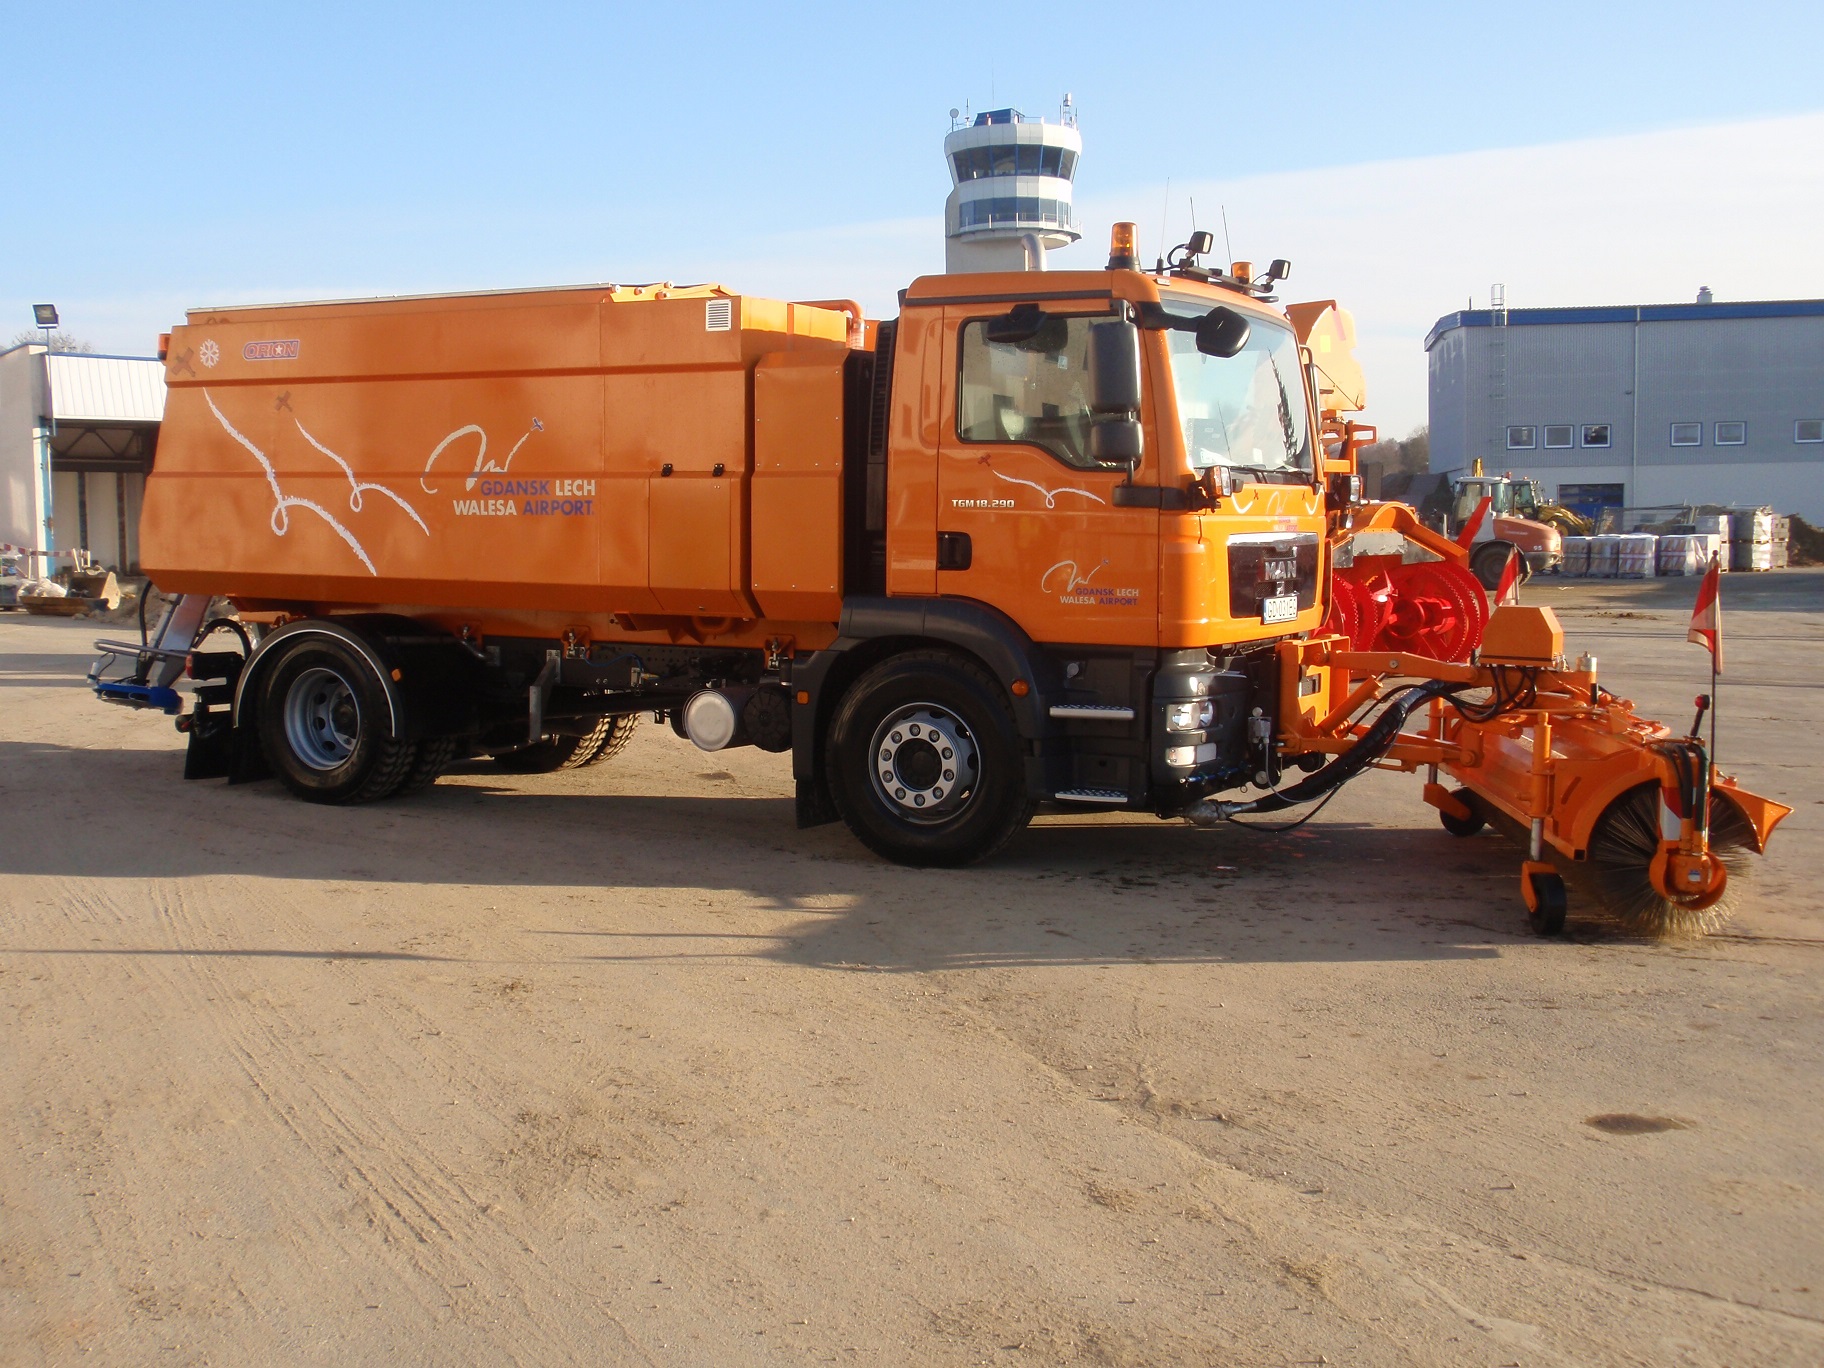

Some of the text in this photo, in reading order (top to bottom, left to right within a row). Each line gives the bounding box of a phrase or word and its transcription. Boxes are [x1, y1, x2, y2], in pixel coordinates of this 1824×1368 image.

[244, 341, 298, 359] ORION
[480, 479, 596, 496] GDANSK LECH
[452, 499, 593, 516] WALESA AIRPORT
[951, 499, 1015, 508] TGM 18.290
[1264, 560, 1297, 580] MAN
[1059, 595, 1138, 606] WALESA AIRPORT
[1075, 587, 1139, 597] GDANSK LECH
